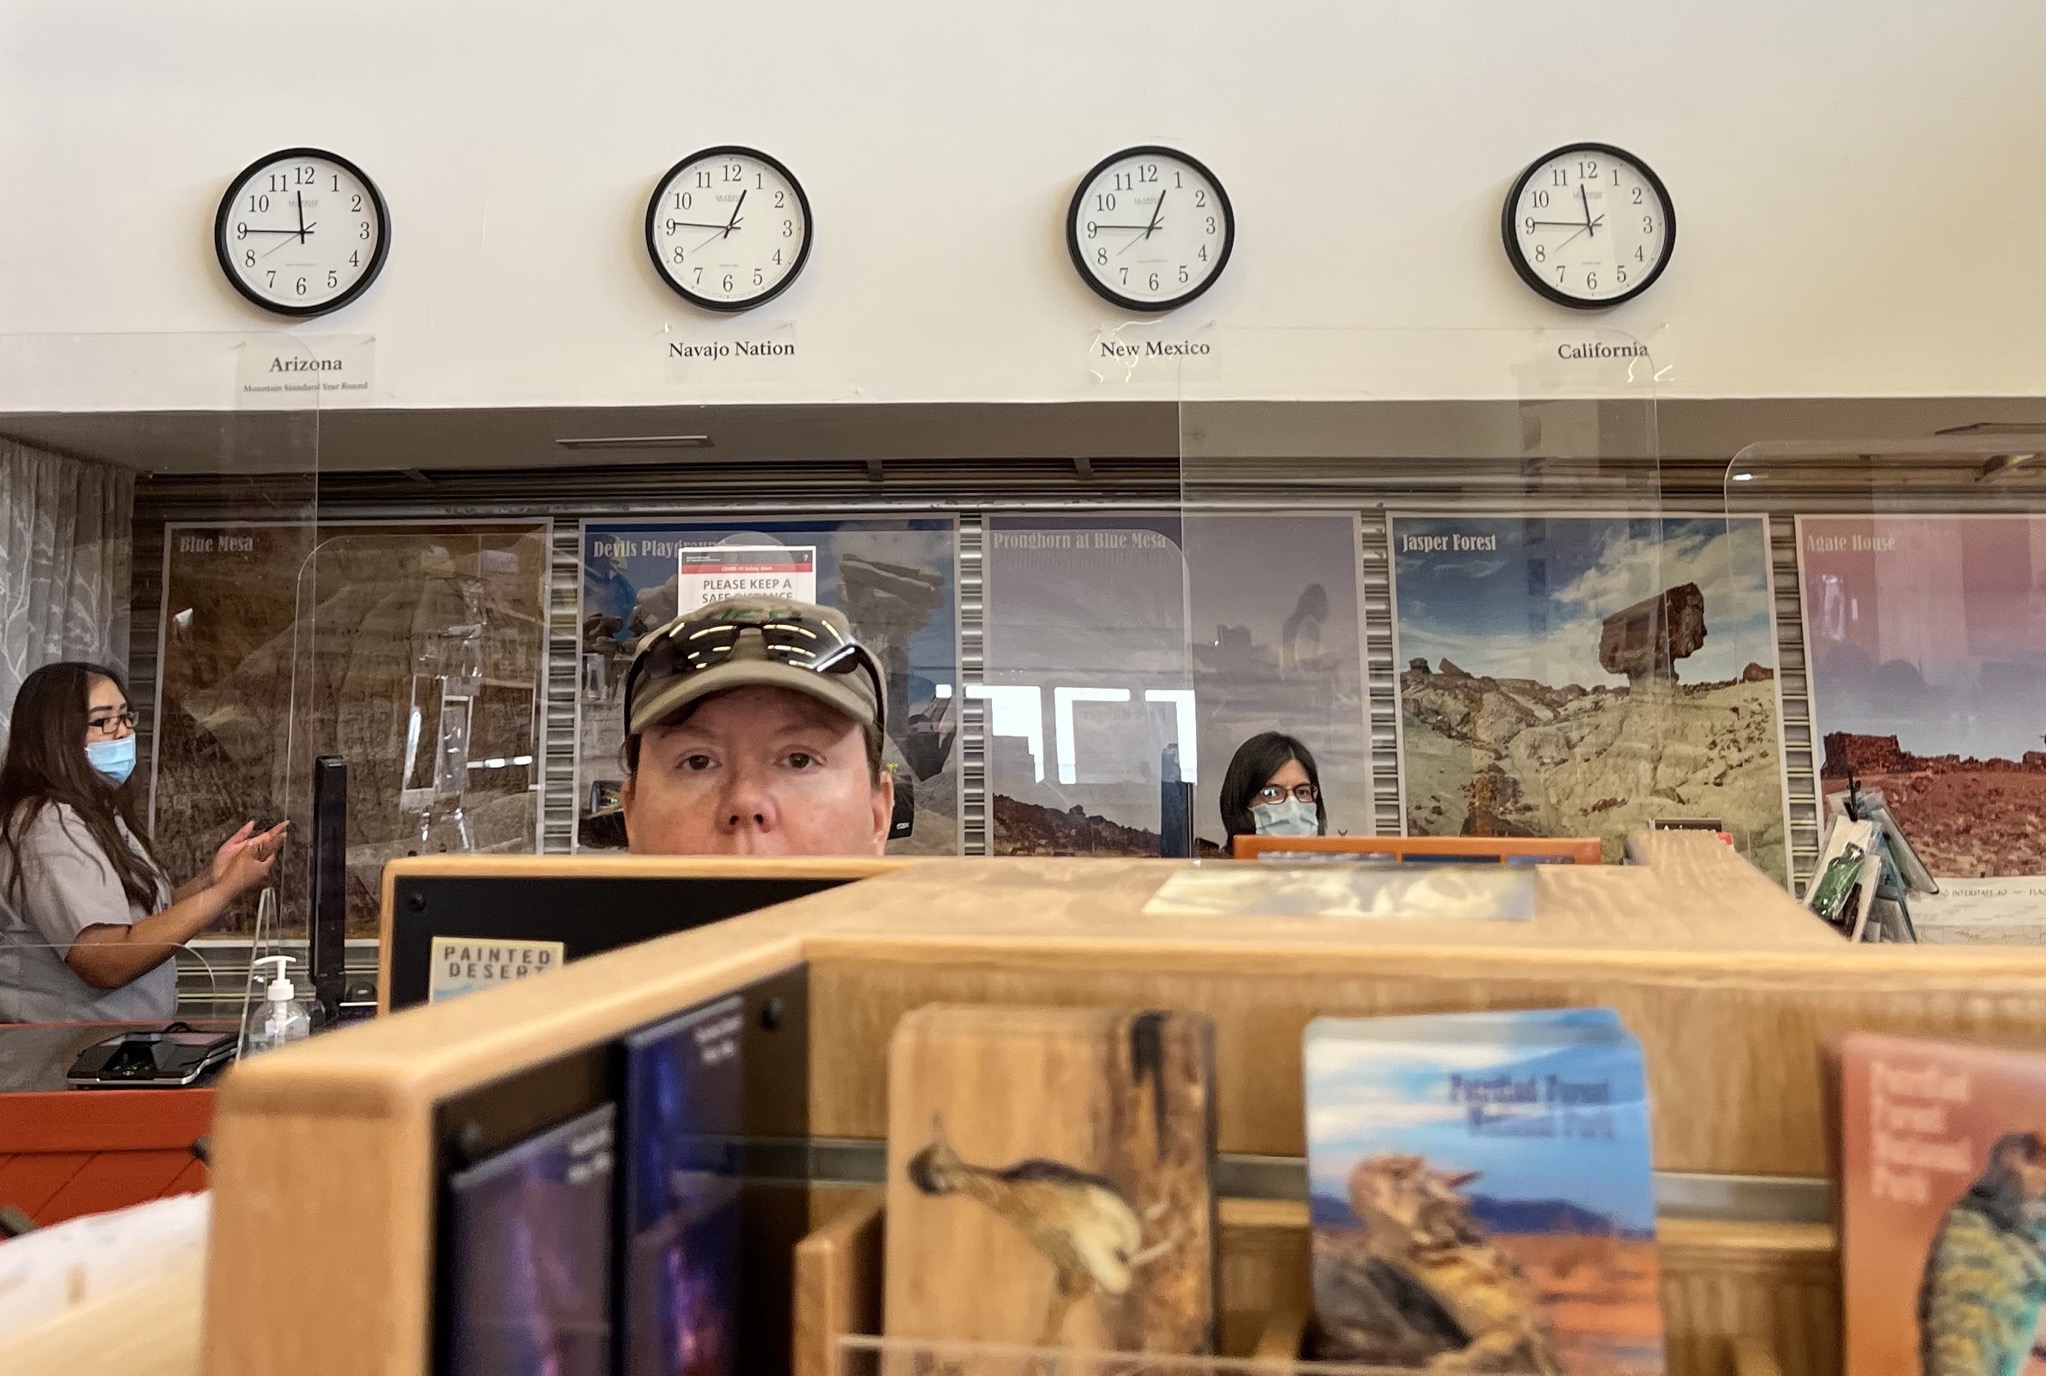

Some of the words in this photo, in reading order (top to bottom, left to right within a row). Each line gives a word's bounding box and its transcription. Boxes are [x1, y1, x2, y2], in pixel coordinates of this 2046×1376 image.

[295, 166, 315, 185] 12
[723, 164, 742, 182] 12
[1139, 164, 1158, 183] 12
[1552, 168, 1569, 186] 11
[1579, 161, 1598, 179] 12
[1612, 168, 1621, 187] 1
[268, 174, 289, 193] 11
[331, 174, 341, 192] 1
[695, 171, 713, 189] 11
[755, 172, 765, 190] 1
[1114, 172, 1134, 191] 11
[1173, 170, 1184, 189] 1
[249, 194, 270, 213] 10
[351, 194, 362, 213] 2
[674, 192, 692, 210] 10
[774, 190, 784, 209] 2
[1097, 193, 1116, 212] 10
[1195, 189, 1206, 208] 2
[1532, 190, 1550, 208] 10
[1631, 186, 1643, 205] 2
[237, 222, 248, 240] 9
[359, 221, 370, 240] 3
[666, 219, 677, 236] 9
[782, 219, 793, 238] 3
[1086, 221, 1098, 239] 9
[1205, 216, 1216, 235] 3
[1525, 217, 1536, 235] 9
[1642, 215, 1653, 234] 3
[245, 250, 256, 267] 8
[348, 249, 359, 267] 4
[673, 246, 684, 264] 8
[772, 248, 781, 266] 4
[1097, 247, 1108, 266] 8
[1197, 244, 1208, 262] 4
[1535, 244, 1546, 263] 8
[1634, 244, 1644, 262] 4
[266, 270, 277, 289] 7
[327, 270, 338, 289] 5
[693, 267, 704, 285] 7
[752, 268, 763, 286] 5
[1119, 267, 1129, 286] 7
[1148, 272, 1159, 291] 6
[1178, 265, 1189, 283] 5
[1556, 265, 1566, 284] 7
[1586, 272, 1598, 290] 6
[1616, 264, 1627, 283] 5
[296, 277, 307, 296] 6
[722, 274, 734, 292] 6
[668, 341, 730, 361] Navajo
[734, 340, 795, 356] Nation
[1100, 342, 1140, 357] New
[1144, 340, 1210, 356] Mexico
[1557, 342, 1648, 359] California
[269, 356, 342, 372] Arizona
[243, 384, 282, 392] Mountain
[284, 383, 320, 392] Standard
[322, 382, 340, 390] Year
[341, 382, 368, 390] Round
[180, 535, 214, 553] Blue
[217, 535, 254, 552] Mesa
[593, 539, 637, 558] Devils
[993, 532, 1071, 550] Pronghorn
[1075, 532, 1089, 549] at
[1094, 532, 1127, 549] Blue
[1132, 532, 1167, 549] Mesa
[1402, 534, 1449, 553] Jasper
[1452, 533, 1496, 551] Forest
[1806, 535, 1848, 553] Agate
[1852, 534, 1896, 551] House
[703, 579, 746, 590] PLEASE
[750, 578, 779, 589] KEEP
[782, 578, 792, 589] A
[1952, 889, 1993, 897] INTERSTATE
[444, 946, 551, 964] PAINTED
